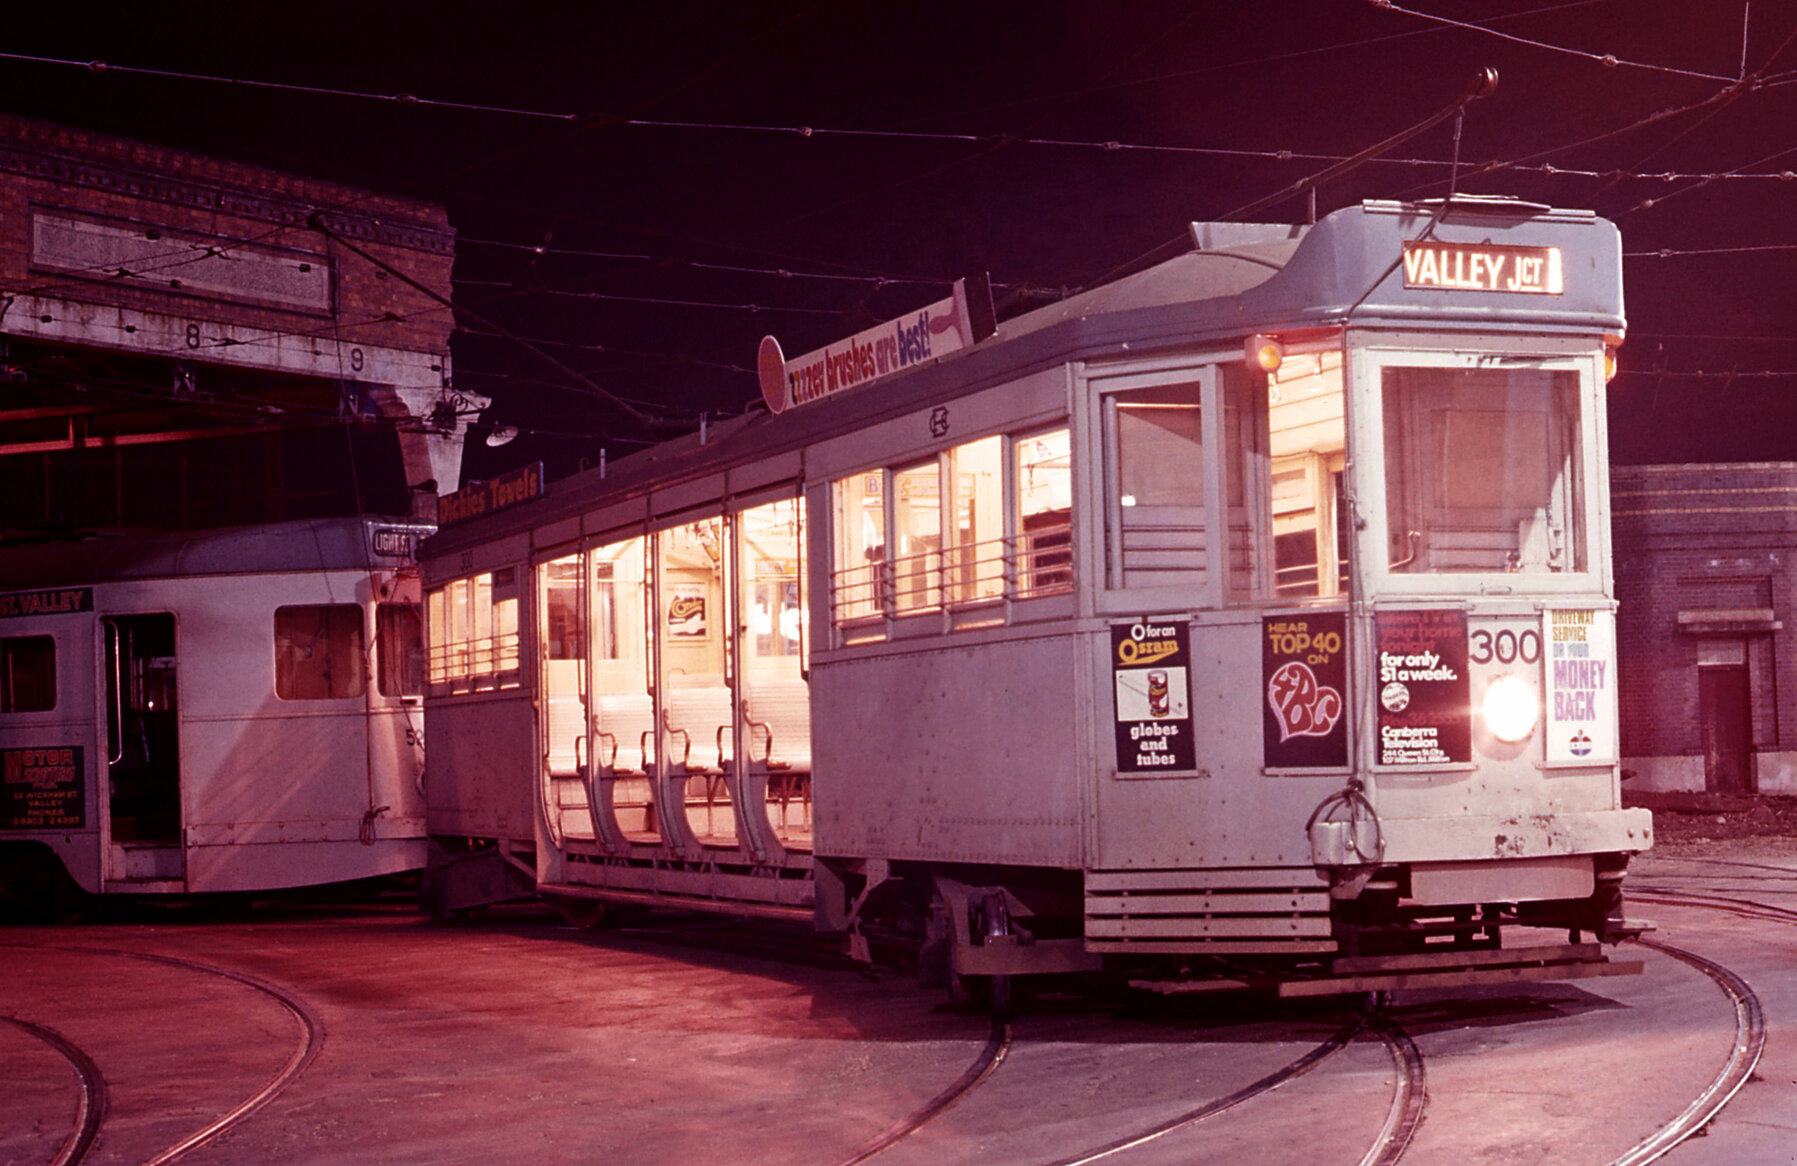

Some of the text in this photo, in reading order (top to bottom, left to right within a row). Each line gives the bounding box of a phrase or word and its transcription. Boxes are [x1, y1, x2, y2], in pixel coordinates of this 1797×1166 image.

[1404, 248, 1544, 291] VALLEY JCT
[186, 324, 200, 349] 8
[351, 348, 364, 371] 9
[825, 338, 876, 393] brushes
[876, 334, 898, 374] are
[897, 311, 932, 366] best!
[490, 468, 537, 510] Towels
[19, 591, 83, 616] VALLEY
[1146, 626, 1161, 638] for
[1162, 626, 1176, 637] an
[1268, 622, 1308, 633] HEAR
[1552, 626, 1587, 642] SERVICE
[1118, 638, 1179, 664] Osram
[1269, 632, 1341, 654] TOP 40
[1470, 629, 1541, 664] 300
[1307, 654, 1329, 664] ON
[1380, 650, 1440, 669] for only
[1381, 665, 1458, 683] $1 a week.
[1553, 660, 1606, 690] MONEY
[1554, 691, 1596, 721] BACK
[1382, 726, 1437, 737] Canberra
[1139, 737, 1168, 751] and
[1382, 736, 1438, 749] Television
[1136, 752, 1176, 766] tubes
[28, 799, 64, 807] VALLEY
